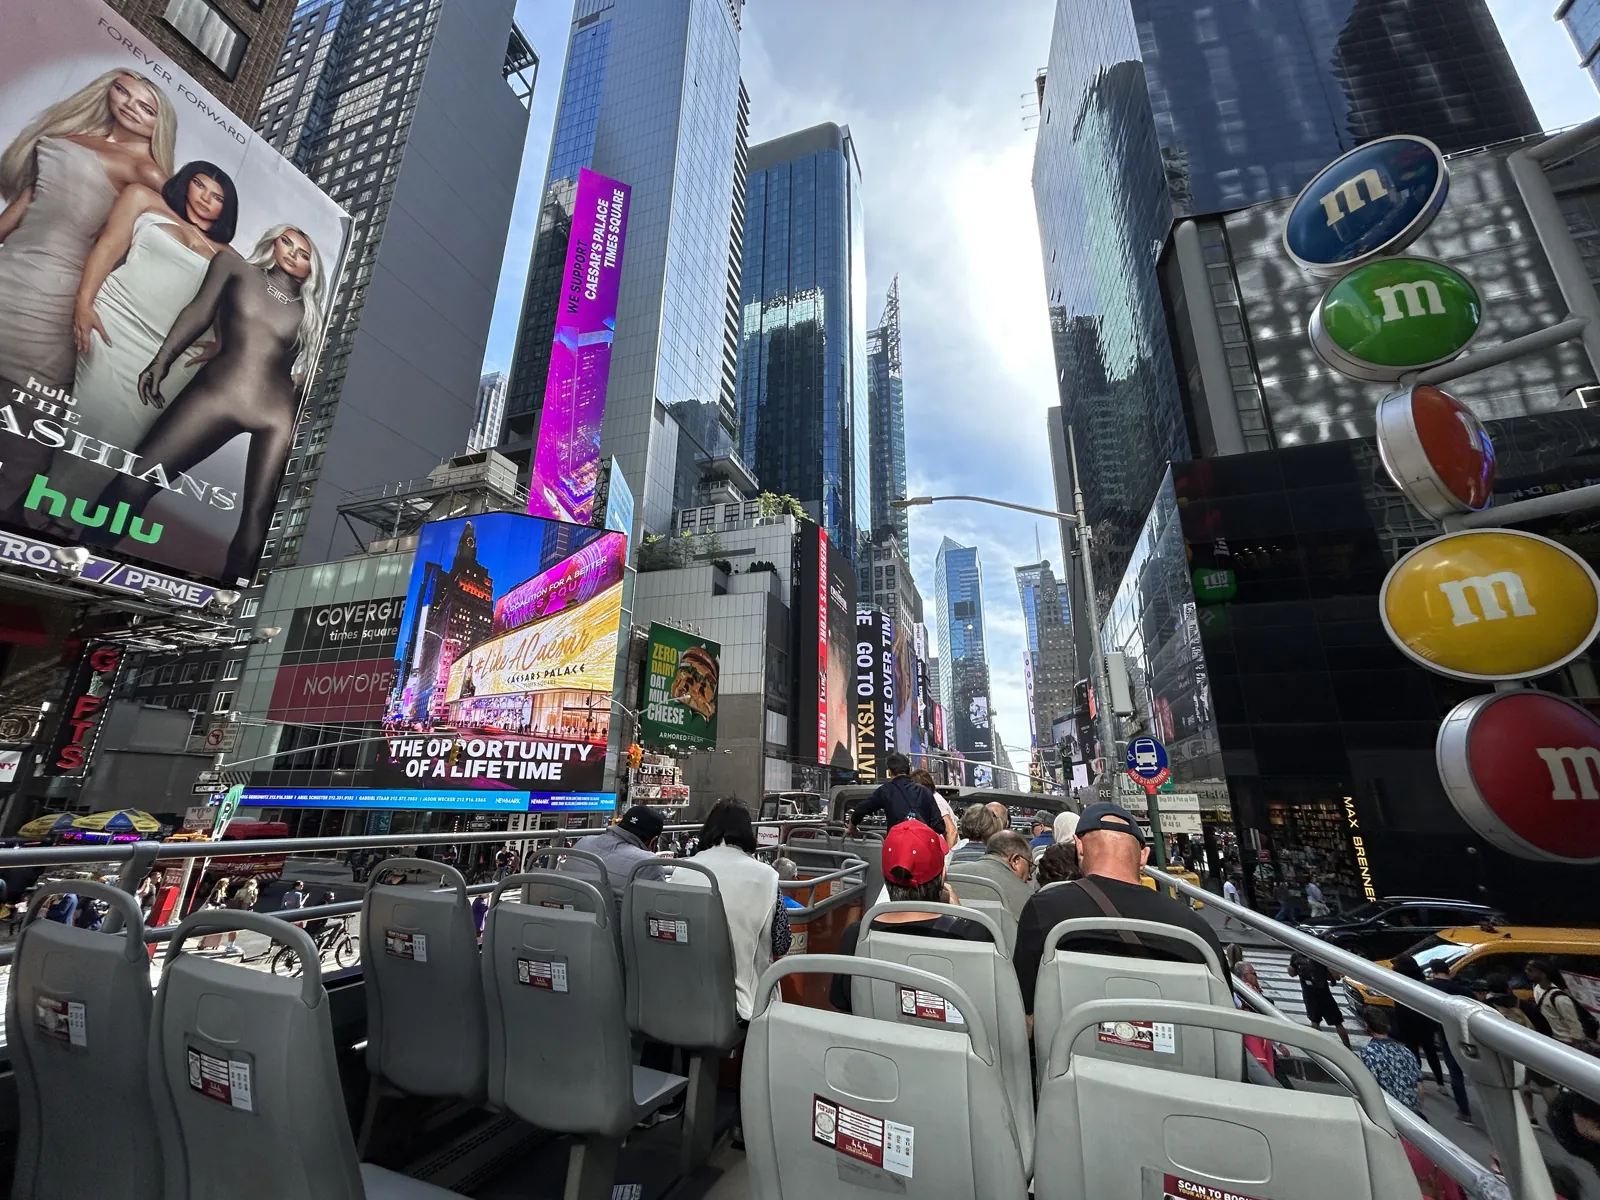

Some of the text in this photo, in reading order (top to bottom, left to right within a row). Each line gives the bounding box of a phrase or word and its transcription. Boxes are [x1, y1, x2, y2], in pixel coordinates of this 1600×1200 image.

[97, 17, 247, 146] FOREVER FORWARD
[1319, 167, 1389, 228] m
[604, 188, 624, 268] TIMES SQUARE
[584, 198, 609, 300] CAESAR'S PALACE
[567, 239, 588, 314] WE SUPPORT
[1374, 278, 1446, 323] m
[26, 376, 78, 406] hulu
[12, 388, 83, 426] THE
[24, 473, 164, 544] hulu
[125, 570, 204, 603] PRIME
[549, 579, 564, 592] FOR
[565, 575, 572, 583] A
[574, 556, 607, 577] BETTER
[549, 565, 607, 601] SQUARE
[818, 539, 828, 645] HERSHEY'S STORE
[1439, 570, 1537, 627] m
[329, 626, 398, 641] times square
[652, 642, 677, 665] ZERO
[856, 642, 873, 668] GO
[507, 663, 585, 684] CAESARS PALACE
[650, 673, 666, 689] OAT
[651, 659, 676, 678] DAIRY
[882, 651, 893, 699] OVER
[302, 674, 350, 697] NOW
[649, 688, 670, 705] MILK
[857, 671, 874, 697] TO
[647, 704, 684, 725] CHEESE
[818, 712, 826, 743] FREE
[883, 702, 895, 752] TAKE
[390, 740, 424, 757] THE
[659, 731, 704, 743] ARMORED FRESH
[405, 759, 563, 780] OF A LIFETIME
[638, 775, 673, 785] LUGGAGE
[640, 767, 674, 776] GIFTS
[1130, 769, 1167, 785] NO STANDING
[661, 787, 689, 799] GIFTS
[1343, 796, 1359, 828] MAX
[1178, 1180, 1206, 1195] SCAN
[1208, 1188, 1222, 1199] TO
[1178, 1187, 1195, 1197] YOUR
